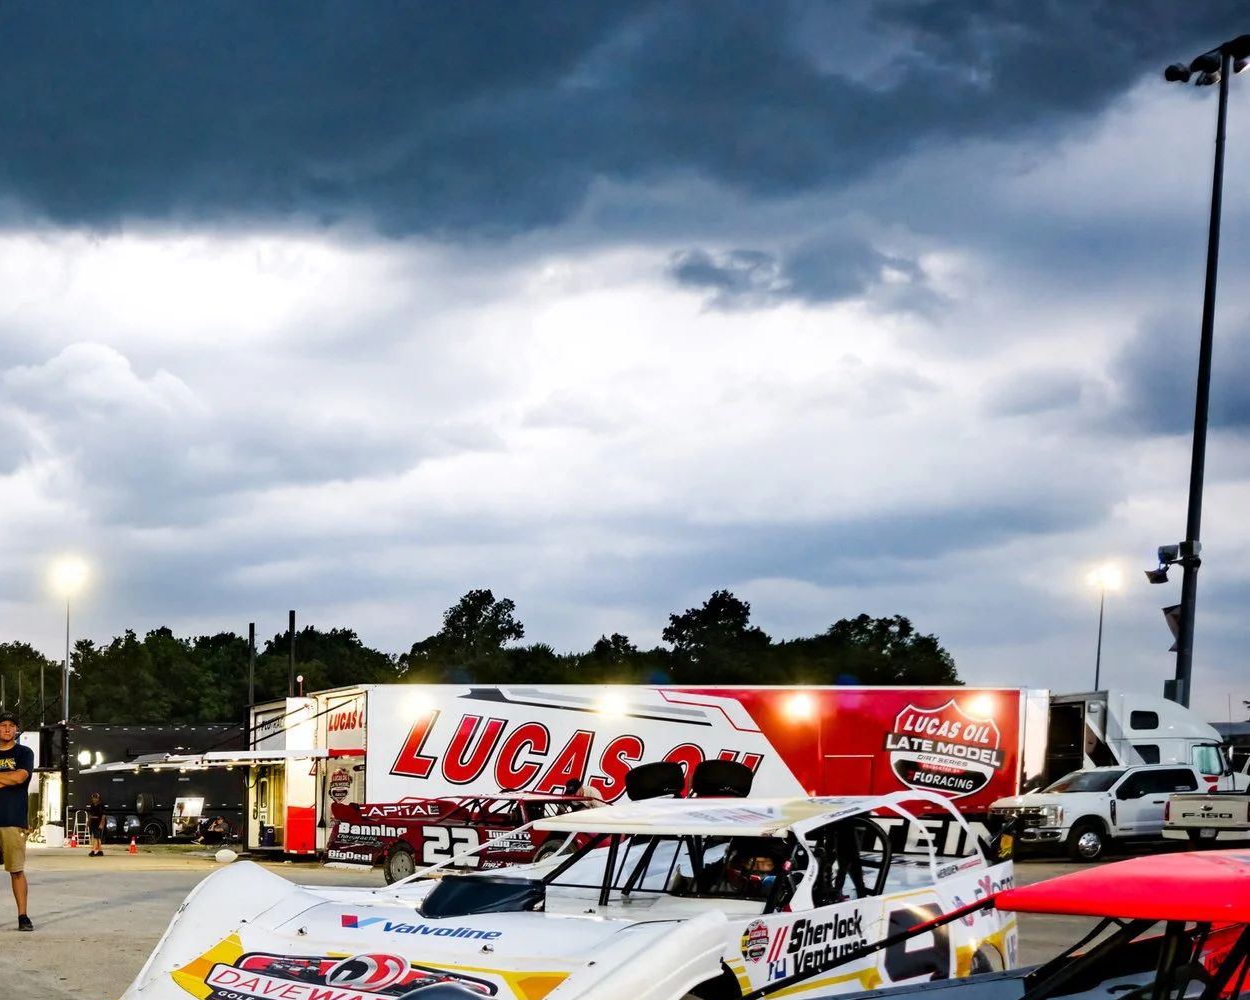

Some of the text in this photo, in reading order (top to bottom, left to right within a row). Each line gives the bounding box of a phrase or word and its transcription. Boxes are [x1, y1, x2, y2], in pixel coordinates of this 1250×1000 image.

[904, 714, 990, 744] LUCAS OIL
[390, 706, 647, 803] LUCAS
[885, 734, 1001, 767] LATE MODEL
[916, 754, 968, 768] DIRT SERIES
[913, 771, 974, 790] FLORACING
[338, 822, 407, 838] Banning
[328, 850, 373, 862] BigDeal
[422, 825, 481, 868] 22
[382, 921, 503, 941] Valvoline
[787, 908, 863, 953] Sherlock
